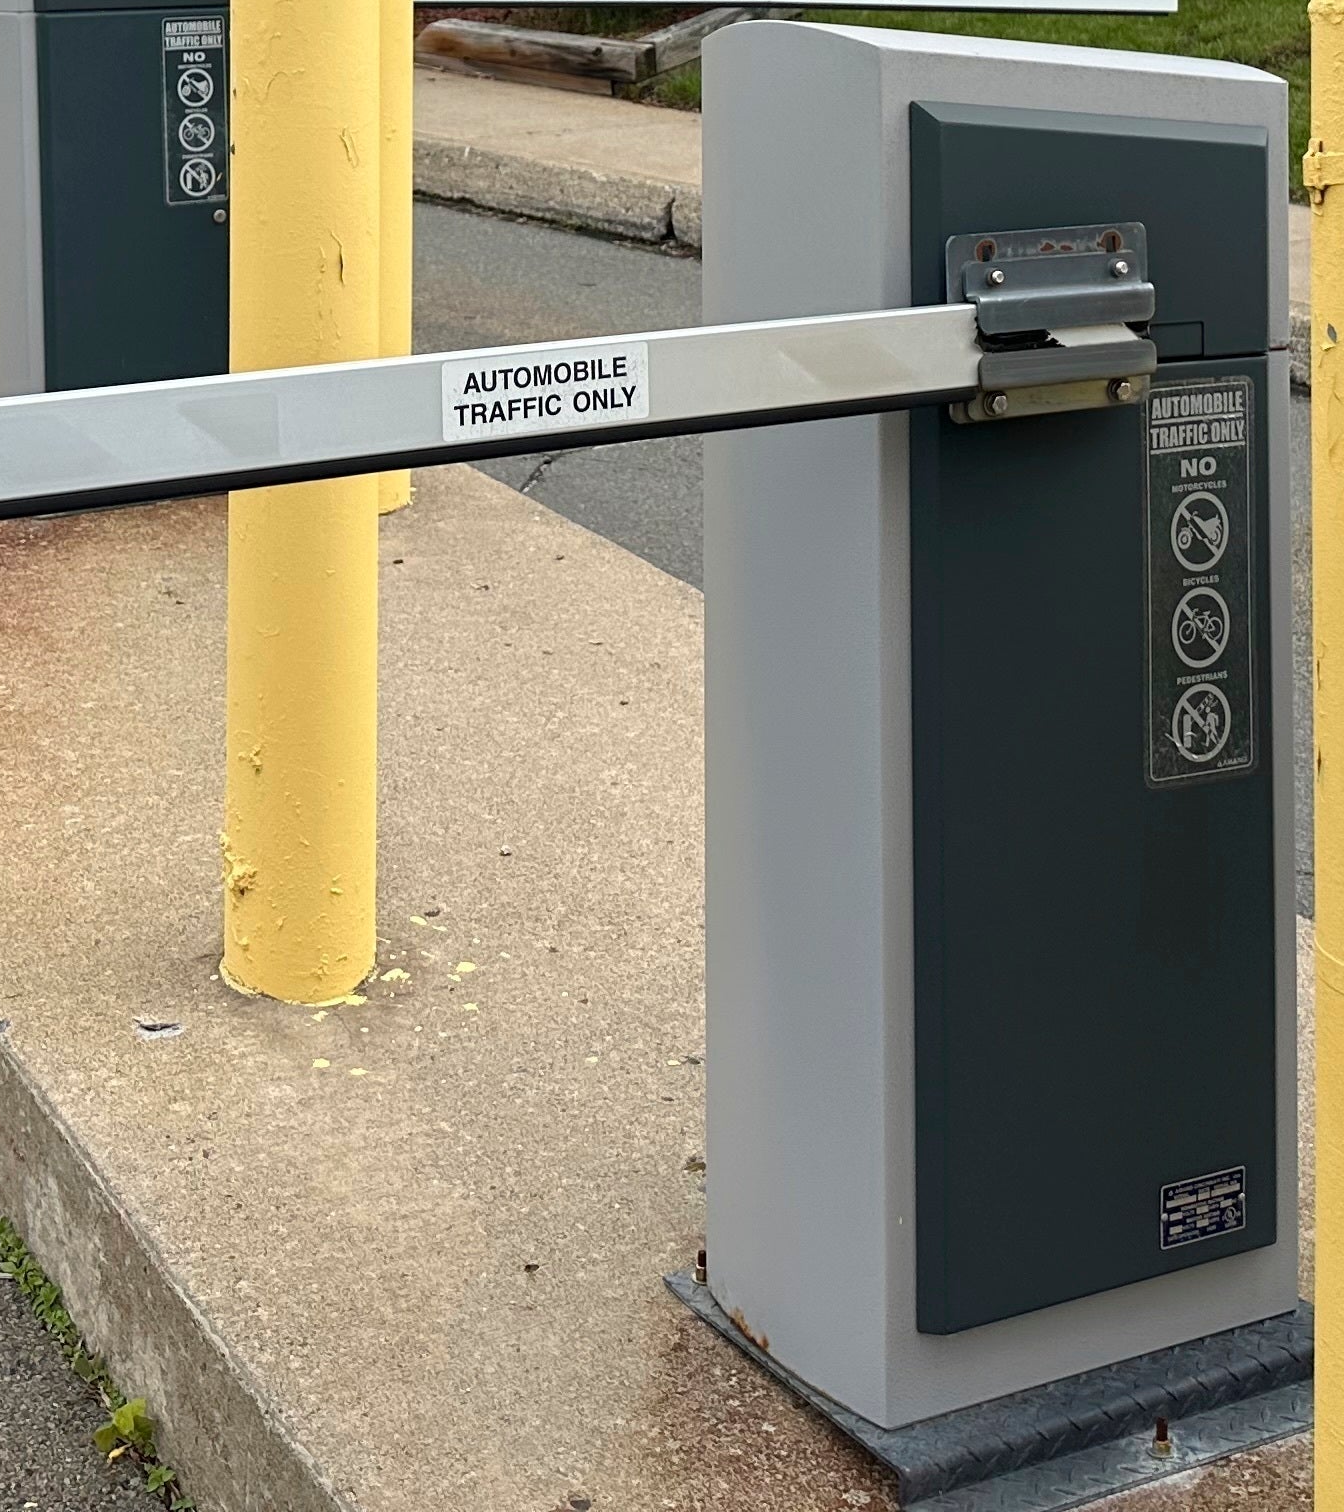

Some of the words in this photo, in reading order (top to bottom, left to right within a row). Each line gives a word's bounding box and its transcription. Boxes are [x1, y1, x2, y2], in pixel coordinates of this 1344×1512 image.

[165, 19, 222, 33] AUTOMOBILE
[164, 35, 200, 47] TRAFFIC
[201, 34, 223, 45] ONLY
[182, 51, 206, 63] NO
[463, 356, 627, 395] AUTOMOBILE
[454, 394, 562, 426] TRAFFIC
[573, 385, 637, 413] ONLY
[1151, 391, 1244, 419] AUTOMOBILE
[1150, 423, 1208, 449] TRAFFIC
[1211, 419, 1245, 442] ONLY
[1180, 456, 1217, 478] NO
[1171, 480, 1227, 493] MOTORCYCLES
[1182, 574, 1220, 587] BICYCLES
[1176, 670, 1228, 685] PEDESTRIANS
